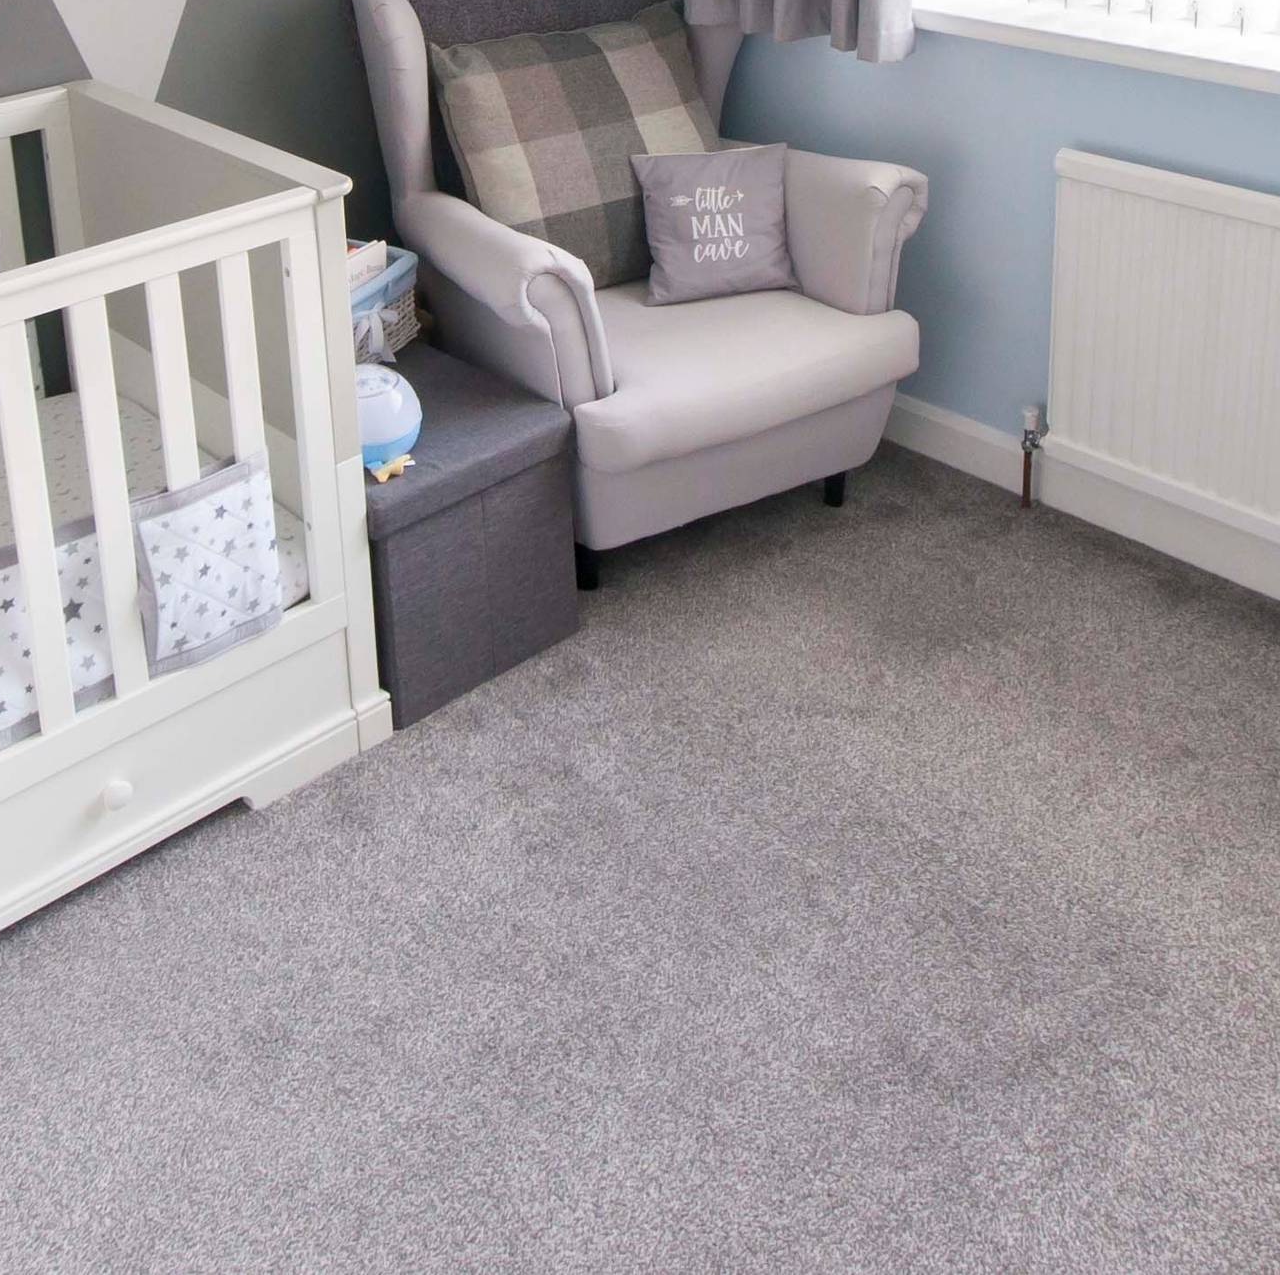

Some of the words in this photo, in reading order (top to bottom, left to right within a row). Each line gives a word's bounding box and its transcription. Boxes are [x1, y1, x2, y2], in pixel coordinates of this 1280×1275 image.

[695, 185, 734, 213] little
[691, 213, 745, 240] MAN
[694, 238, 750, 264] cave
